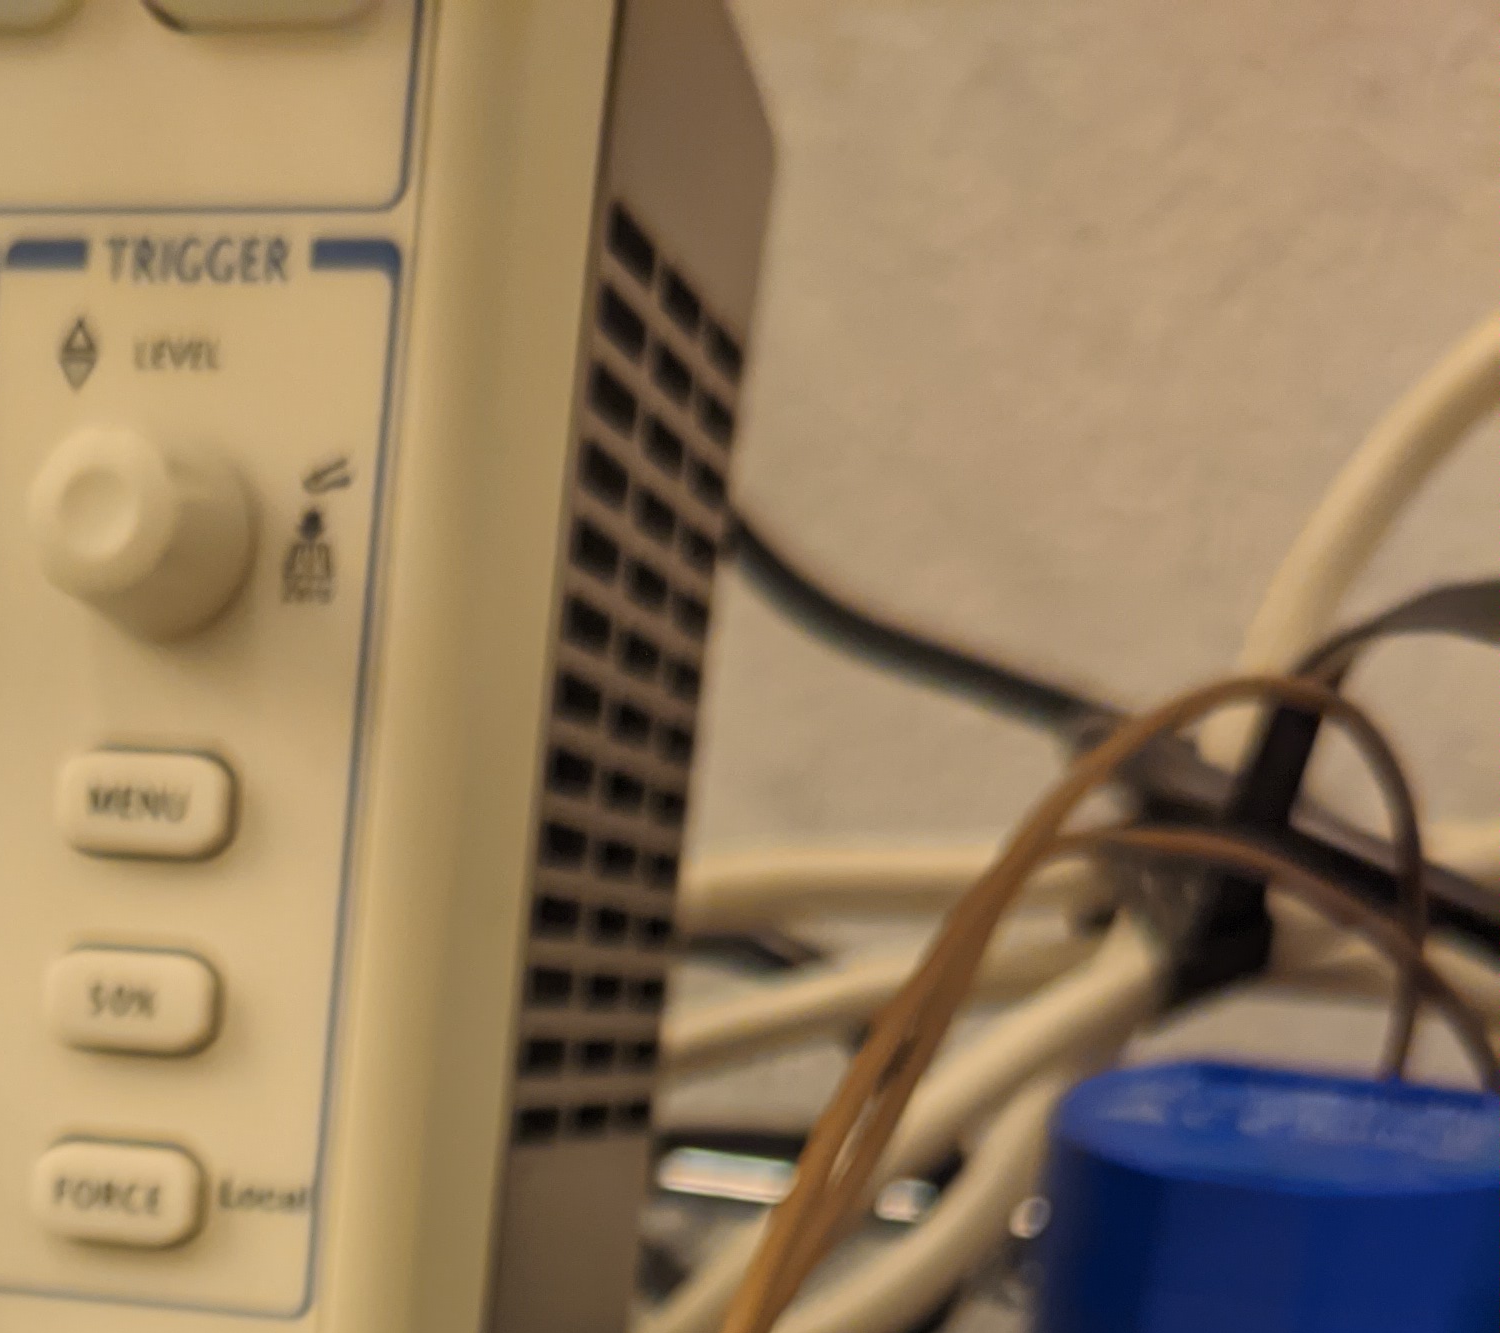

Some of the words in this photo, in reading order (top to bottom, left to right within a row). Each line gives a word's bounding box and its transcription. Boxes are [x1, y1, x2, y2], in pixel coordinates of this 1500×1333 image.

[107, 236, 290, 285] TRIGGER
[134, 338, 219, 373] LEVEL
[86, 784, 190, 822] MENU
[53, 1176, 163, 1215] FORCE
[218, 1180, 308, 1211] Local
